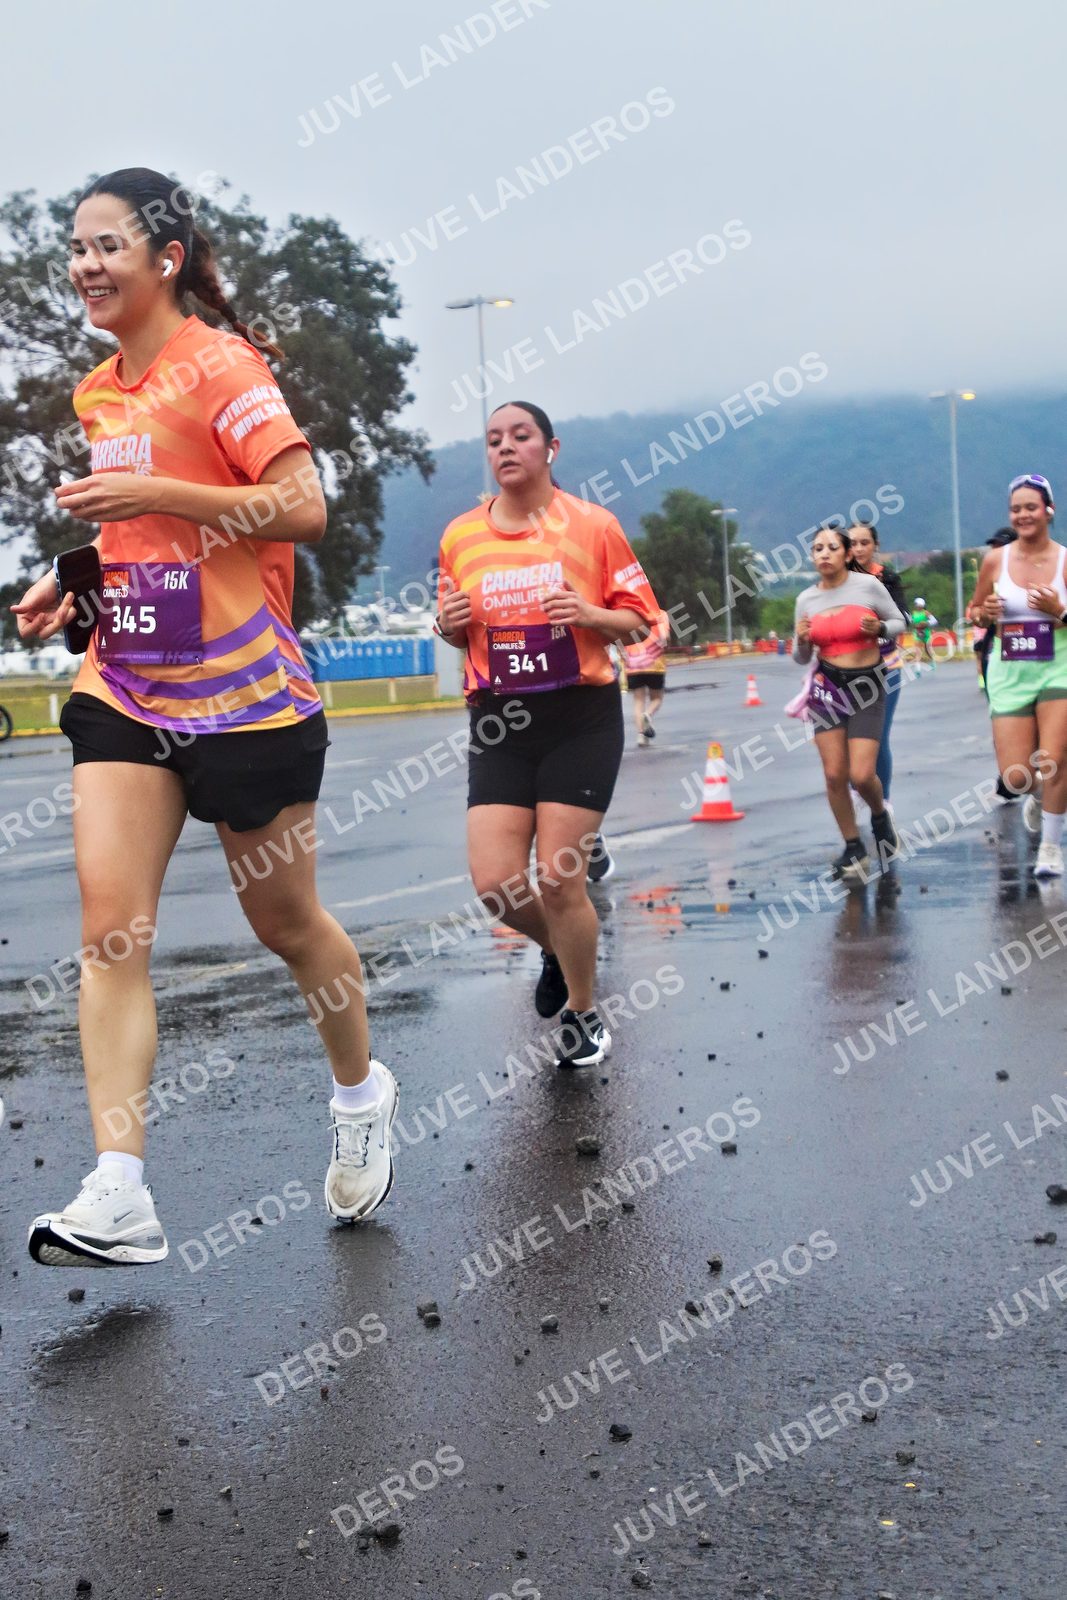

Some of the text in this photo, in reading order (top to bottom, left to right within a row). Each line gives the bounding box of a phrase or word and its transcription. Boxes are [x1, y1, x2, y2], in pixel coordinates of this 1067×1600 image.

[163, 570, 190, 590] 15K
[482, 561, 563, 595] CARRERA
[112, 605, 157, 634] 345
[492, 631, 526, 643] CARRERA
[550, 625, 567, 641] 15K
[1010, 637, 1037, 651] 398
[508, 652, 549, 675] 341
